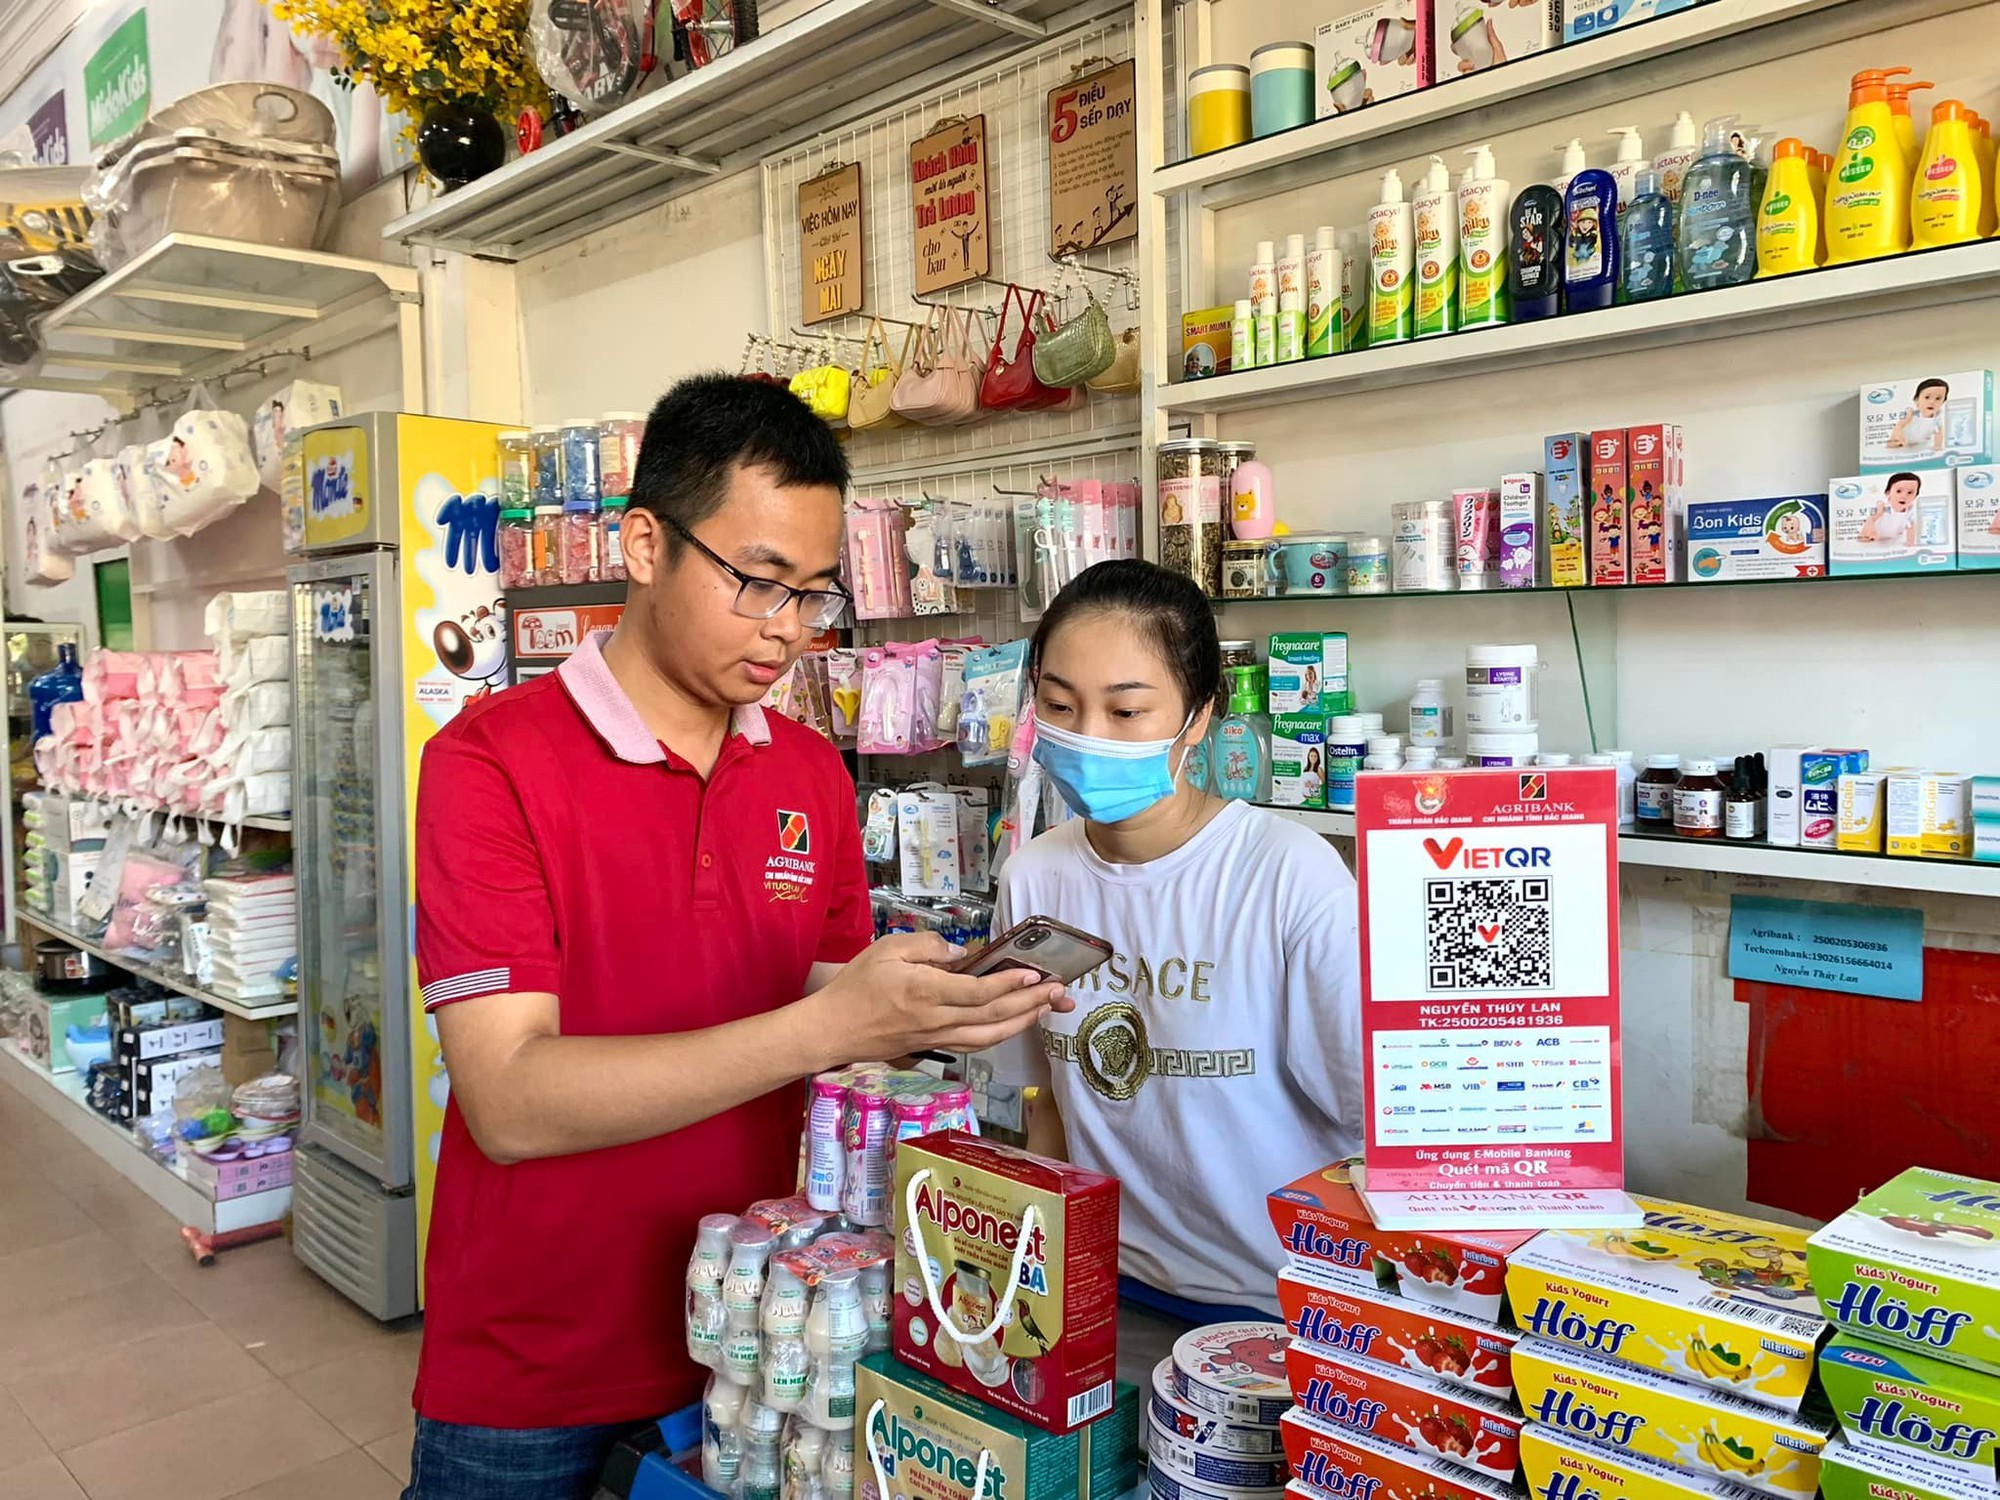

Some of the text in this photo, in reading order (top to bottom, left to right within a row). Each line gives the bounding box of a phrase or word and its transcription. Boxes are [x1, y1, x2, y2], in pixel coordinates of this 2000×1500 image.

[1335, 12, 1374, 30] BABY BOTTLE
[1051, 81, 1106, 144] 5 ĐIỀU
[1080, 98, 1132, 130] SẾP DẠY
[912, 142, 978, 184] Khách Hàng
[1694, 189, 1720, 202] D-nee
[801, 200, 858, 236] VIỆC HÔM NAY
[916, 190, 976, 229] Trả Lương
[1520, 213, 1543, 228] STAR
[922, 238, 941, 258] cho
[813, 249, 847, 284] NGÀY
[927, 256, 946, 276] bạn
[819, 283, 843, 314] MAI
[1186, 321, 1226, 337] SMART MUM
[1692, 513, 1762, 530] Bon Kids
[1271, 635, 1320, 656] Pregnacare
[1223, 726, 1244, 736] aiko
[1273, 714, 1322, 734] Pregnacare
[1301, 732, 1320, 743] max
[1329, 745, 1357, 756] Ostelin
[1491, 802, 1575, 815] AGRIBANK
[1842, 780, 1854, 831] BioGaia
[1924, 780, 1937, 832] BioGaia
[1450, 815, 1473, 824] GIANG
[1482, 814, 1495, 823] CHI
[1561, 812, 1585, 821] GIANG
[1422, 836, 1552, 870] VIETQR
[765, 856, 816, 874] AGRIBANK
[1750, 927, 1889, 953] Agribank 2500205306936
[1067, 953, 1215, 1001] RSACE
[1839, 972, 1859, 984] Lan
[1420, 1001, 1561, 1016] NGUYỄN THÚY LAN
[1419, 1014, 1563, 1028] TK:2500205481936
[1536, 1038, 1560, 1047] ACB
[1572, 1080, 1589, 1088] CB
[1415, 1148, 1572, 1161] Ứng dụng E-Mobile Banking
[1438, 1160, 1549, 1178] Quét mã QR
[1429, 1180, 1466, 1191] Chuyển
[1493, 1180, 1500, 1189] &
[1504, 1179, 1534, 1189] thanh
[1406, 1192, 1590, 1201] AGRIBANK QR
[1537, 1203, 1572, 1212] thanh
[1296, 1209, 1349, 1231] Kids Yogurt
[1283, 1222, 1372, 1268] Höff
[1462, 1249, 1500, 1267] Interbos
[1855, 1264, 1940, 1297] Kids Yogurt
[1307, 1291, 1361, 1316] Kids Yogurt
[1545, 1282, 1611, 1308] Kids Yogurt
[1825, 1280, 1973, 1348] Höff
[1291, 1306, 1383, 1354] Höff
[1522, 1297, 1637, 1354] Höff
[1759, 1336, 1806, 1360] Interbos
[789, 1373, 808, 1385] MEN
[1315, 1363, 1367, 1390] Kids Yogurt
[1552, 1373, 1620, 1401] Kids Yogurt
[1296, 1377, 1388, 1431] Höff
[1873, 1380, 1962, 1413] Kids Yogurt
[1479, 1416, 1518, 1438] Interbos
[1529, 1388, 1648, 1446] Höff
[1844, 1396, 1997, 1460] Höff
[1310, 1436, 1362, 1465] Kids Yogurt
[909, 1467, 926, 1482] PHÁT
[1293, 1450, 1383, 1500] Höff
[1559, 1456, 1625, 1487] Kids Yogurt
[1868, 1482, 1903, 1500] Kids
